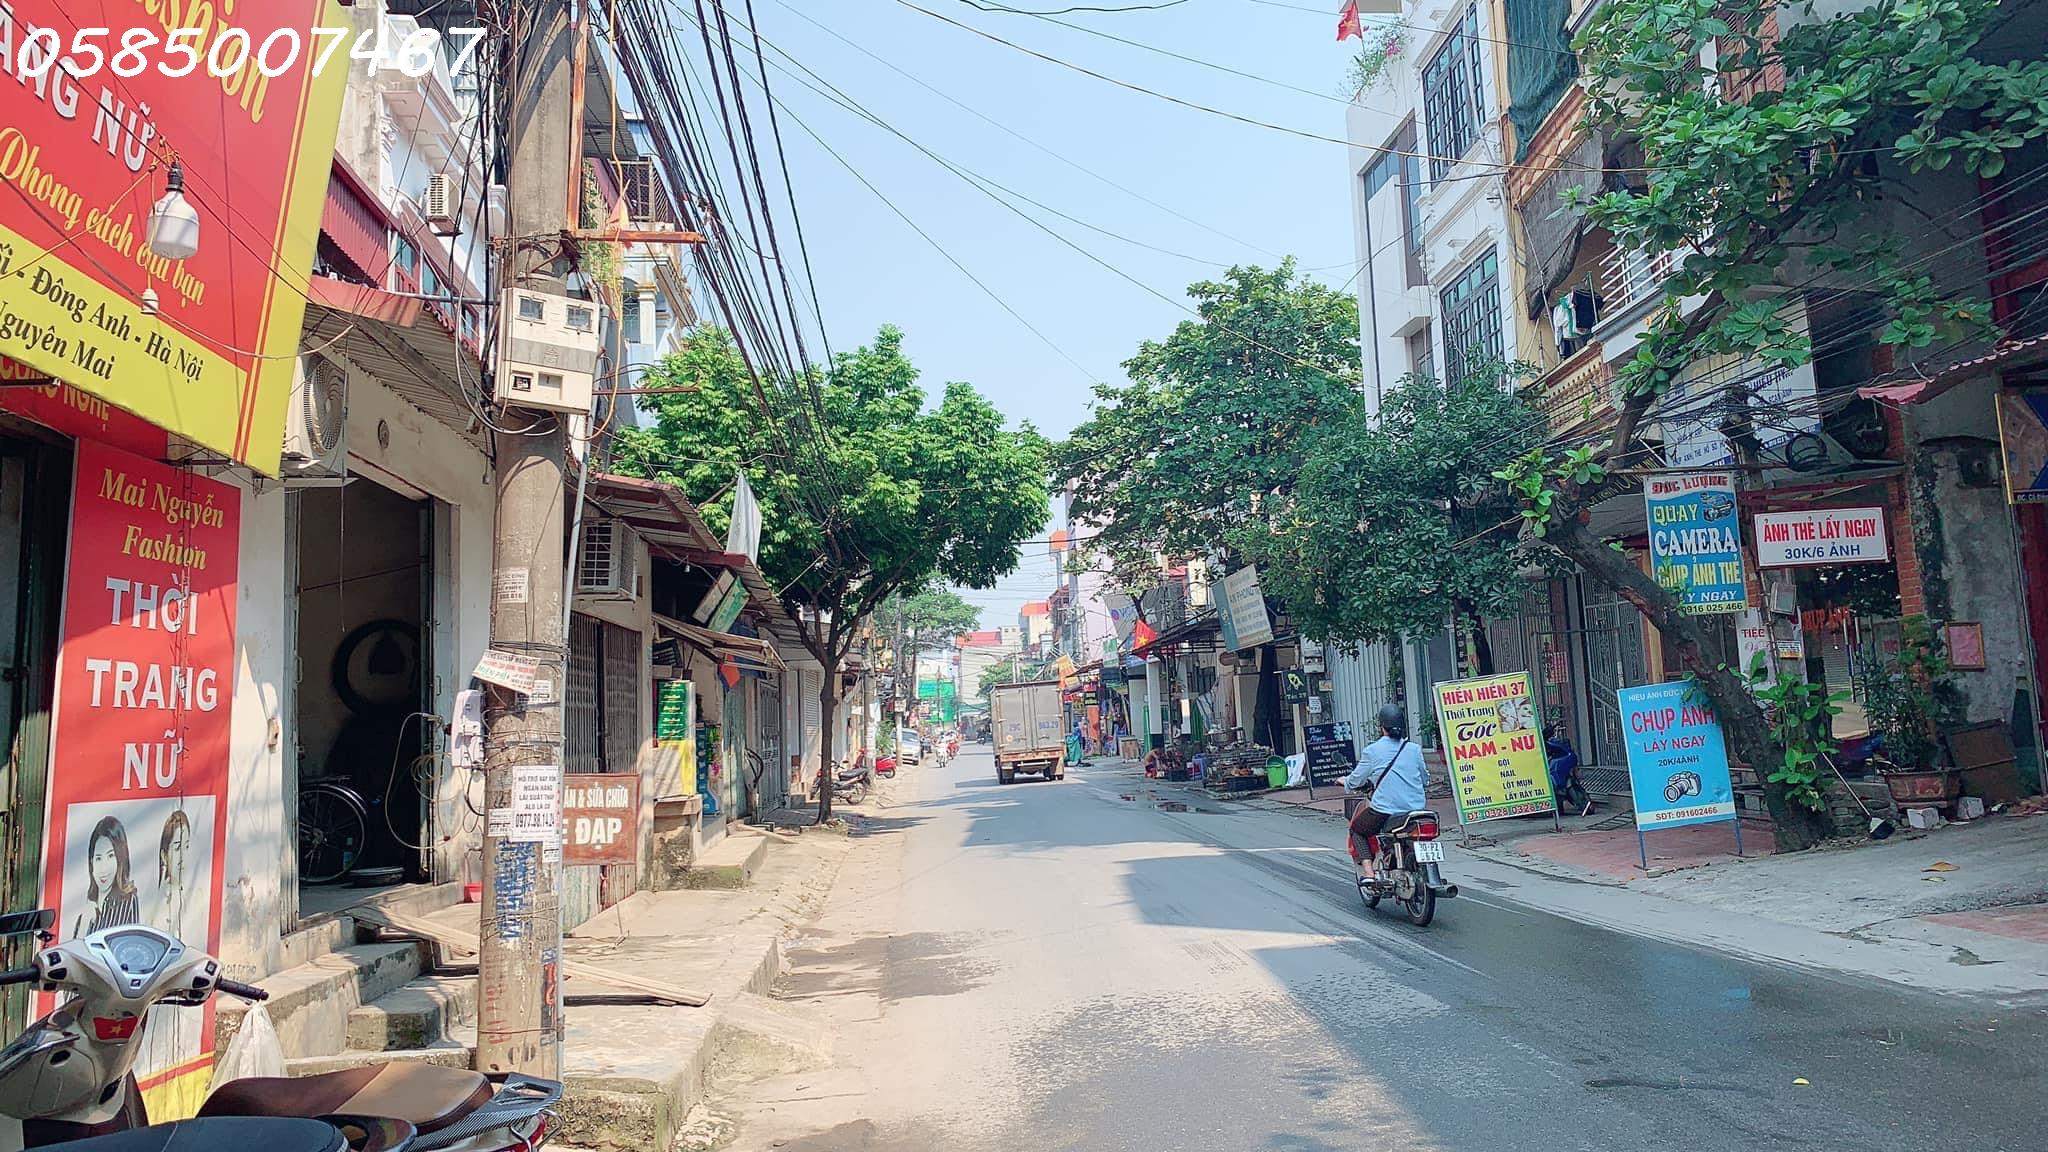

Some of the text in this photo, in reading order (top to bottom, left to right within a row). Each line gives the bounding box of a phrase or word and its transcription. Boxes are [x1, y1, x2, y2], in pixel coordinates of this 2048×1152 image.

[137, 0, 269, 124] shion
[92, 85, 157, 172] NỮ
[0, 128, 84, 230] Phong
[173, 259, 206, 308] bạn
[30, 265, 88, 324] Đông
[88, 302, 130, 341] Anh
[144, 331, 170, 364] Hà
[174, 347, 204, 384] Nội
[71, 340, 115, 380] Mai
[98, 467, 225, 530] Mai Nguyễn
[1653, 503, 1698, 526] QUAY
[1763, 514, 1876, 542] ẢNH THẺ LẤY NGAY
[122, 524, 206, 570] Fashion
[1654, 527, 1738, 556] CAMERA
[1785, 542, 1860, 559] 30K/6 ẢNH
[106, 573, 199, 635] THỜI
[1701, 590, 1738, 602] NGAY
[1707, 603, 1724, 612] 025
[85, 656, 218, 712] TRANG
[1510, 681, 1525, 696] 37
[1466, 706, 1495, 718] Trang
[1631, 708, 1675, 735] CHỤP
[1456, 720, 1497, 742] Tóc
[1671, 735, 1706, 749] NGAY
[121, 728, 183, 790] NỮ
[1454, 740, 1498, 760] NAM
[1500, 769, 1516, 778] NAIL
[563, 782, 629, 808] ÁN & SỬA CHỮA
[1655, 812, 1674, 821] SĐT:
[562, 817, 622, 850] E ĐẠP
